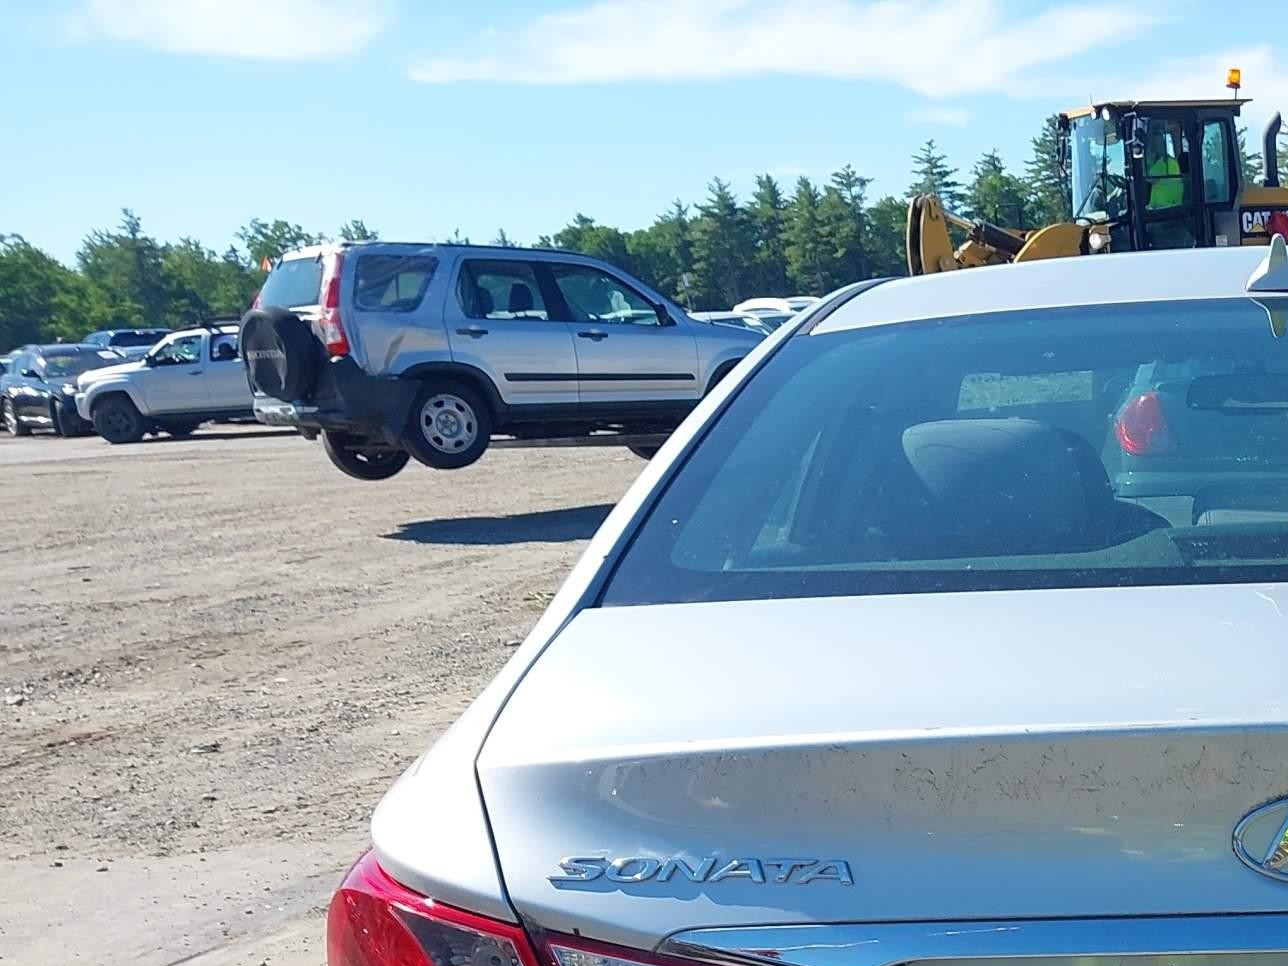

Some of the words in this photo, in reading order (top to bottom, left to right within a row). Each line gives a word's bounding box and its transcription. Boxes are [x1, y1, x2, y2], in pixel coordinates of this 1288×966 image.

[1242, 211, 1271, 233] CAT
[246, 349, 286, 360] HONDA
[546, 855, 854, 886] SONATA
